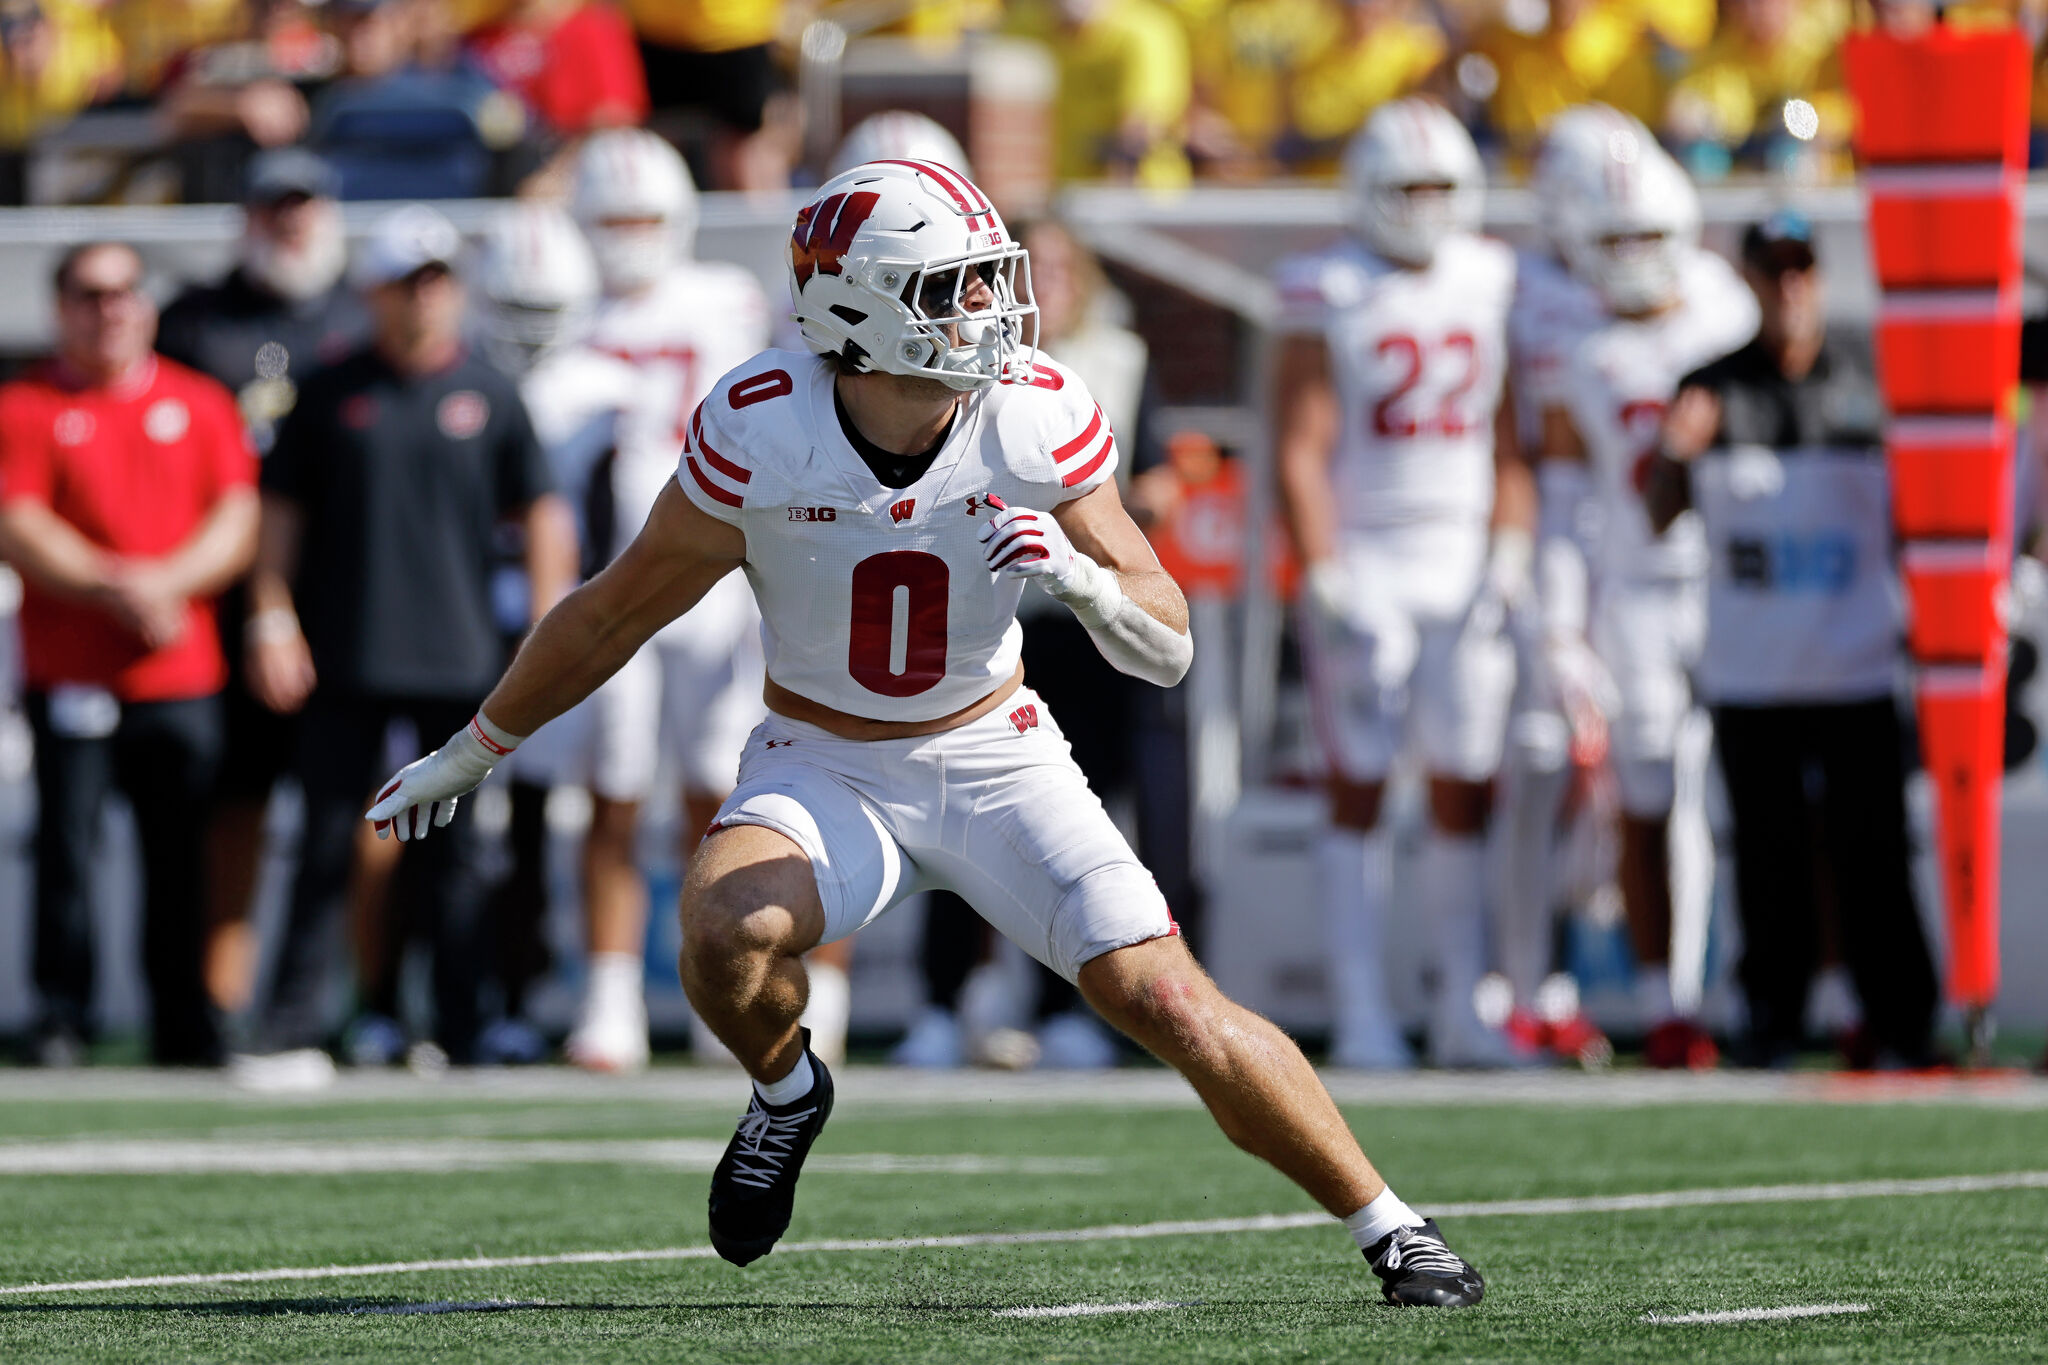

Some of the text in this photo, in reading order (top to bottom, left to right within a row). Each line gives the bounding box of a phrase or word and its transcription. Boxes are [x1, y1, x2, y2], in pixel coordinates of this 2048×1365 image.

[728, 369, 793, 410] 0
[1372, 332, 1479, 438] 22
[889, 498, 916, 525] W
[849, 550, 950, 698] 0
